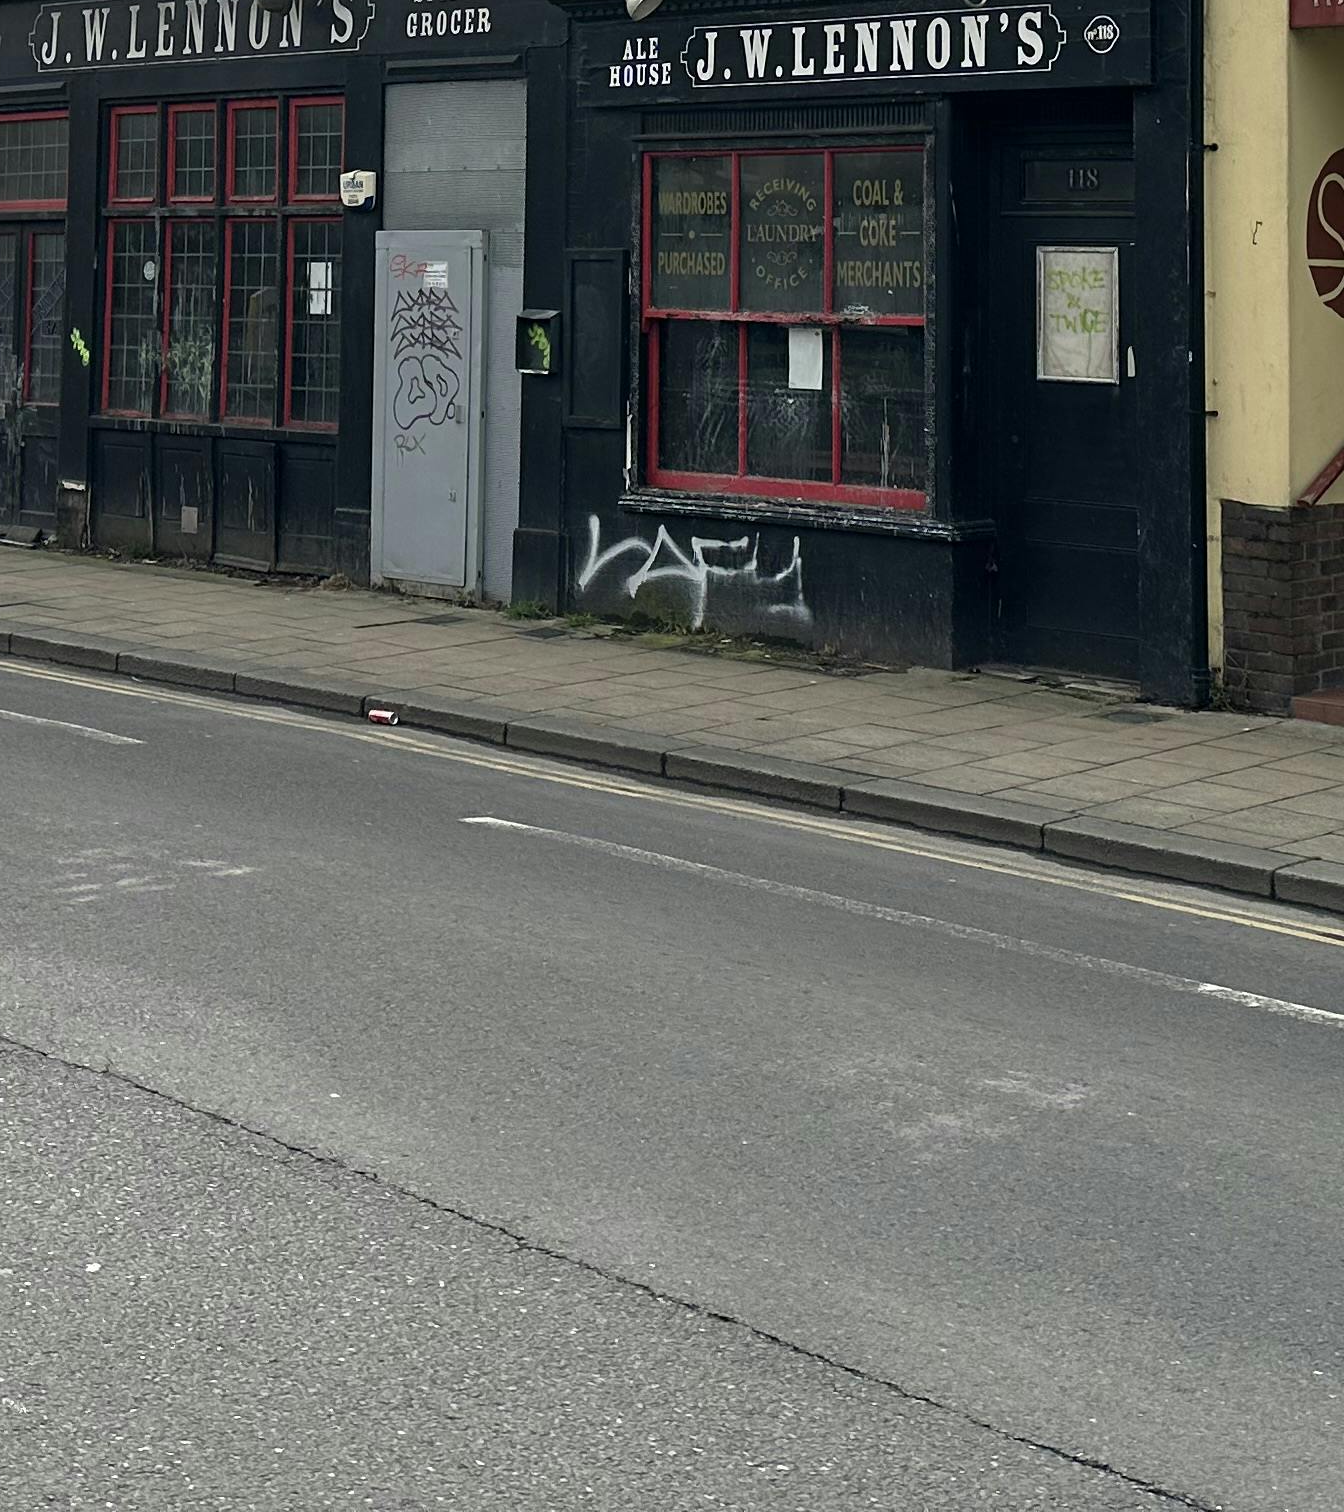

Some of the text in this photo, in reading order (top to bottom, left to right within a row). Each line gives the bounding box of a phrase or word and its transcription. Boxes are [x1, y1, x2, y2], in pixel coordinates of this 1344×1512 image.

[406, 7, 492, 38] GROCER
[623, 37, 659, 60] ALE
[609, 62, 671, 88] HOUSE
[1068, 167, 1099, 189] 118
[659, 191, 727, 216] WARDROBES
[749, 178, 817, 212] RECEIVING
[853, 178, 904, 206] COAL &
[747, 223, 818, 243] LAUNDRY
[859, 220, 898, 247] COKE
[658, 251, 726, 275] PURCHASED
[837, 260, 921, 288] MERCHANTS
[756, 264, 809, 289] OFFICE
